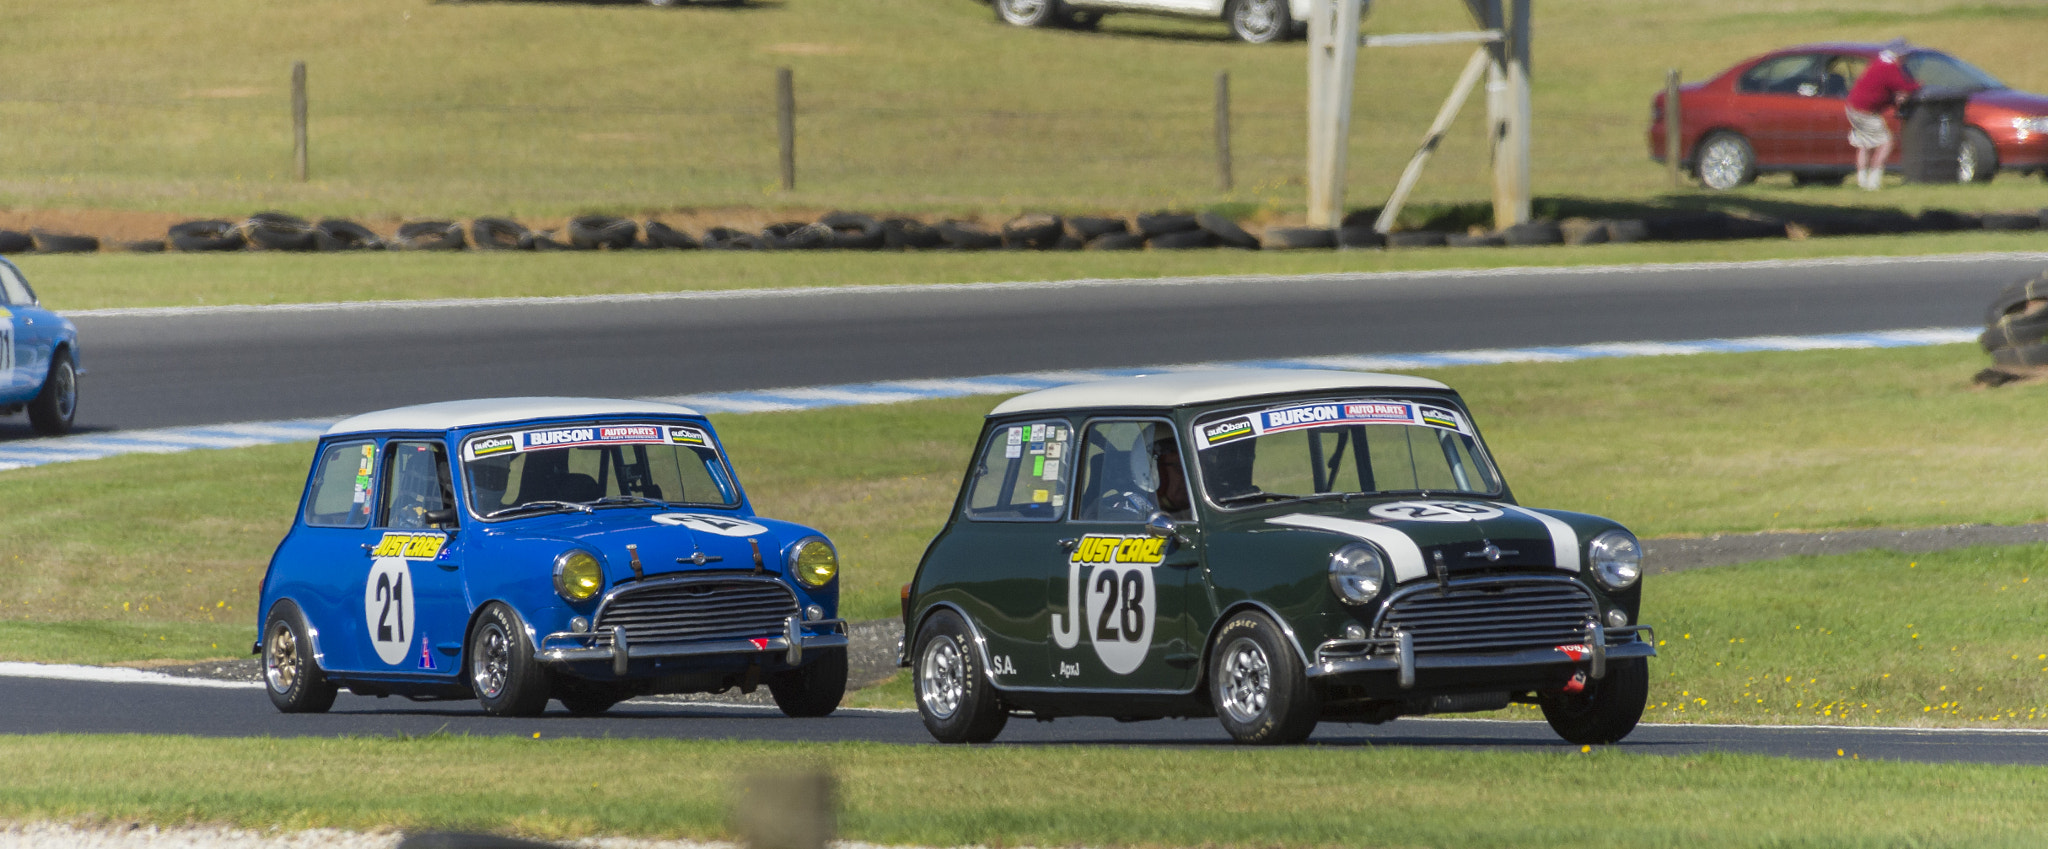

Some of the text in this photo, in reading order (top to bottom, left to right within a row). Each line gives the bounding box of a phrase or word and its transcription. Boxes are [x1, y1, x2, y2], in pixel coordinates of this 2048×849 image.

[1269, 406, 1339, 426] BURSON
[1350, 405, 1404, 414] AUTO PARTS
[530, 429, 593, 445] BURSON
[604, 428, 655, 436] AUTO PARTS
[373, 534, 445, 558] JUST CARS
[1072, 537, 1121, 562] JUST
[375, 572, 405, 643] 21
[1095, 569, 1145, 643] 28
[993, 655, 1017, 675] S.A.
